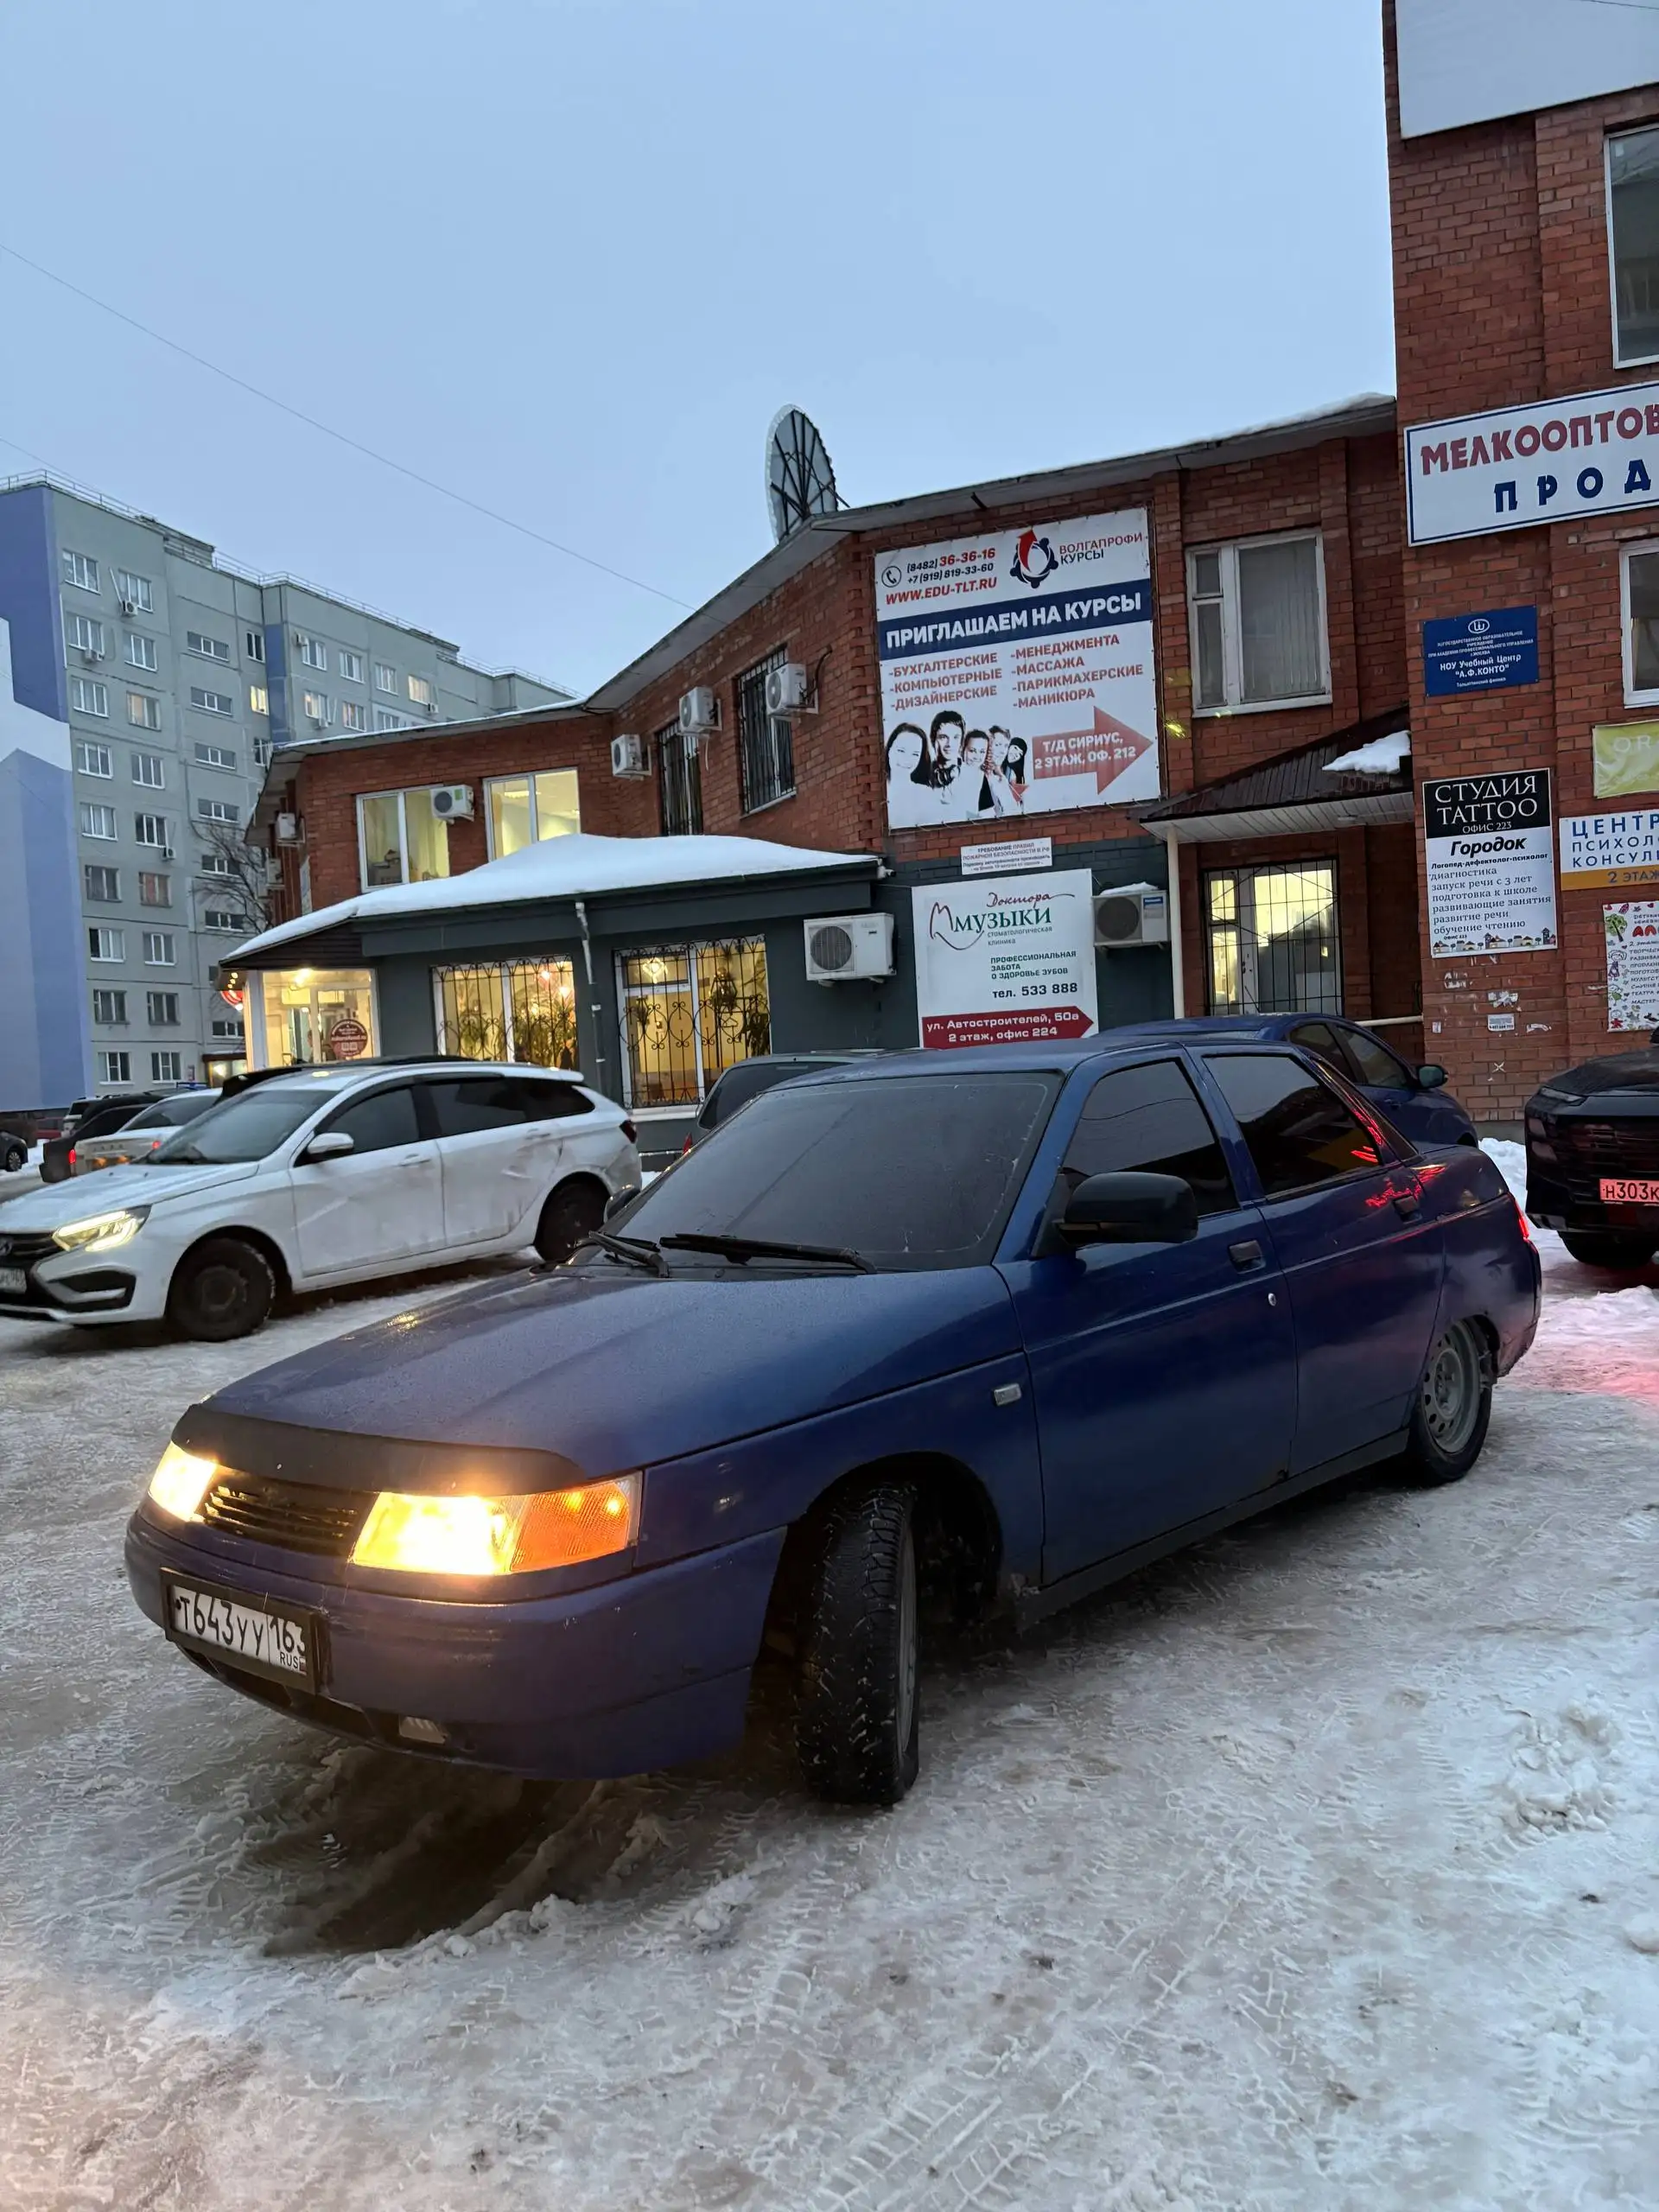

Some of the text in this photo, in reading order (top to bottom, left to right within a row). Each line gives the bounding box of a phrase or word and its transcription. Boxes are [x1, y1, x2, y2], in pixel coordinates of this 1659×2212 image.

[1494, 459, 1651, 513] ПРОД
[1059, 532, 1142, 555] ВОЛГАПРОФИ
[907, 548, 996, 574] (8482) 36-36-16
[1060, 550, 1104, 565] КУРСЫ
[908, 563, 994, 584] +7 (919) 819-33-60
[886, 577, 997, 605] WWW.EDU-TLT.RU
[887, 592, 1141, 649] ПРИГЛАШАЕМ НА КУРСЫ
[1440, 654, 1522, 671] НОУ Учебный Центр
[1043, 739, 1065, 753] Т/Д
[1034, 759, 1043, 769] 2
[1088, 751, 1111, 763] ОФ.
[1114, 747, 1136, 760] 212
[1435, 775, 1537, 804] СТУДИЯ
[1462, 821, 1512, 835] ОФИС 223
[1451, 836, 1528, 859] Городок
[1573, 835, 1659, 852] ПСИХОЛ
[1432, 853, 1548, 869] Логопед-дефектолог-психолог
[1431, 868, 1497, 880] диагностика
[1608, 871, 1618, 883] 2
[1432, 881, 1465, 892] запуск
[1469, 880, 1493, 888] речи
[1504, 877, 1511, 886] 3
[987, 892, 1068, 908] Доктора
[1432, 891, 1491, 904] подготовка
[1503, 887, 1538, 896] школе
[1433, 896, 1552, 914] развивающие занятия
[1433, 911, 1510, 925] развитие речи
[988, 926, 1052, 938] стоматологическая
[1433, 920, 1526, 936] обучение чтению
[991, 950, 1077, 964] ПРОФЕССИОНАЛЬНАЯ
[999, 969, 1040, 980] ЗДОРОВЬЕ
[993, 982, 1078, 999] тел. 533 888
[927, 1012, 1079, 1032] ул. Автостроителей, 50а
[960, 1033, 994, 1042] этаж,
[996, 1028, 1029, 1039] офис
[1033, 1027, 1058, 1037] 224
[280, 1651, 299, 1669] RUS
